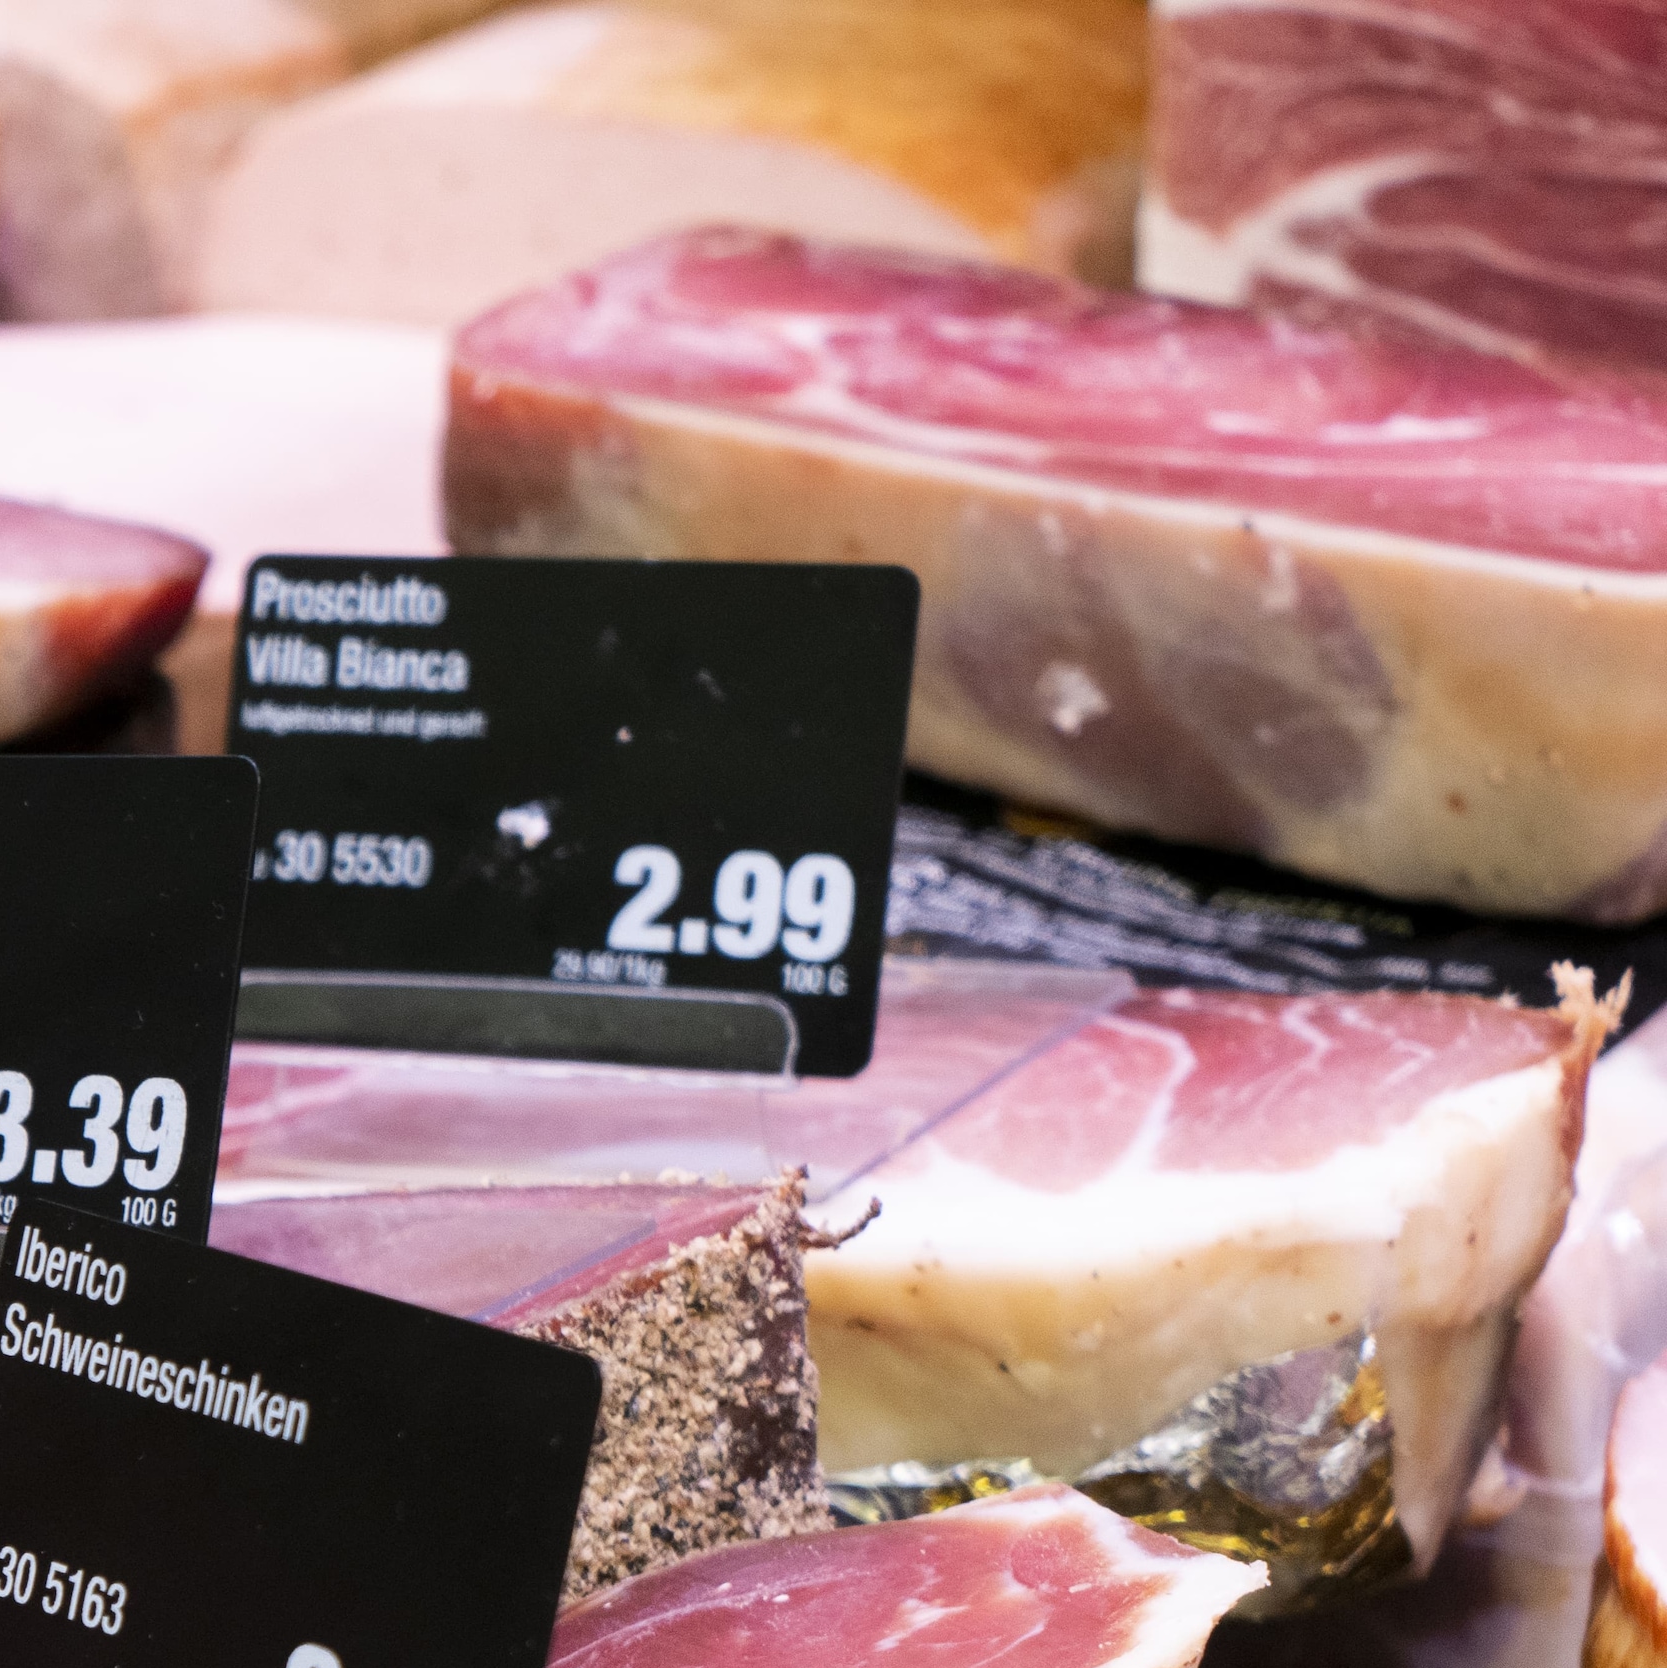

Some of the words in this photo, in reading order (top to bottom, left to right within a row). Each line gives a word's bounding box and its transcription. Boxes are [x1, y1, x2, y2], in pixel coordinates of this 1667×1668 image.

[251, 568, 448, 627] Prosciutto
[246, 636, 328, 688] Villa
[336, 637, 469, 694] Bianca
[273, 829, 327, 881] 30
[332, 831, 433, 888] 5530
[607, 844, 856, 962] 2.99
[552, 949, 666, 990] 29.90/1kg
[781, 962, 825, 995] 100
[828, 965, 849, 997] G
[120, 1195, 159, 1227] 100
[161, 1198, 177, 1227] G
[15, 1223, 126, 1307] Iberico
[0, 1301, 310, 1446] Schweineschinken
[42, 1559, 127, 1637] 5163
